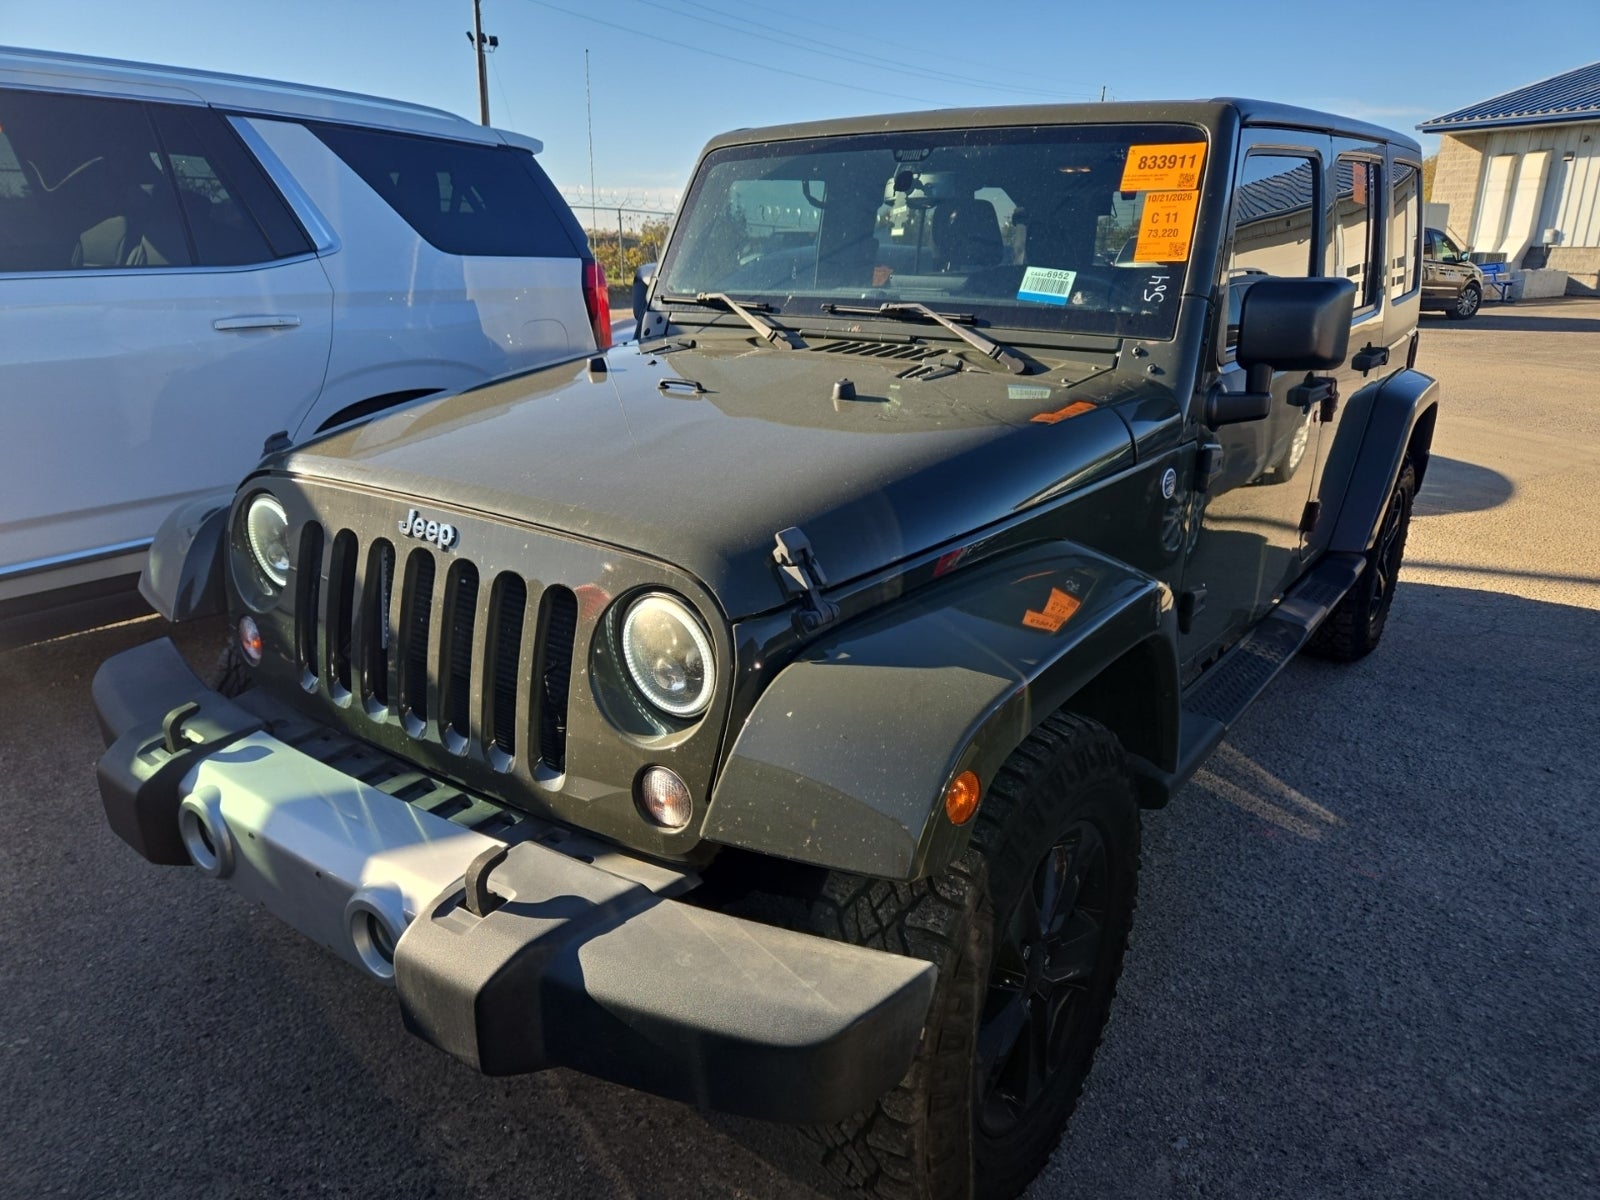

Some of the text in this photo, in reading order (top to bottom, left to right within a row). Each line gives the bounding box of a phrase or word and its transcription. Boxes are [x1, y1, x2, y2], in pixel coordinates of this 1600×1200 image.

[1138, 154, 1197, 170] 833911
[1151, 211, 1179, 224] C 11
[1147, 228, 1179, 239] 73,220
[397, 508, 457, 550] Jeep
